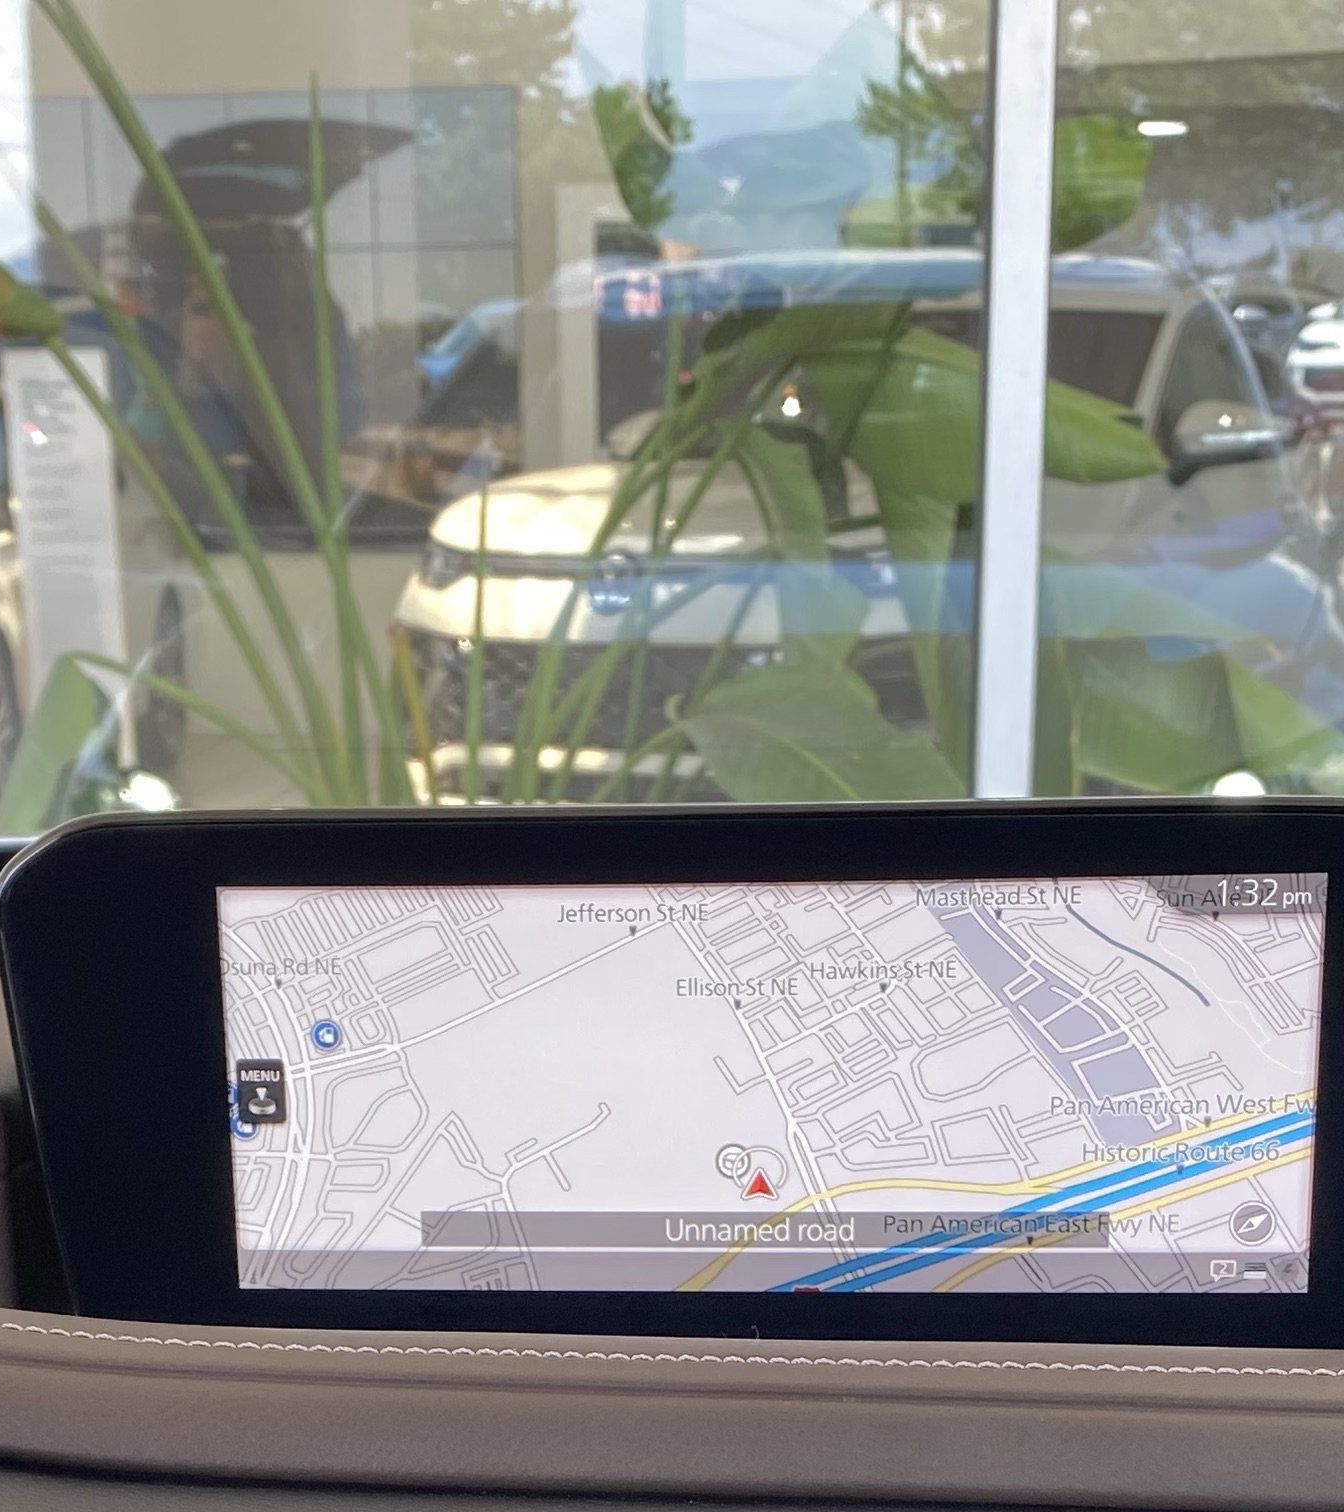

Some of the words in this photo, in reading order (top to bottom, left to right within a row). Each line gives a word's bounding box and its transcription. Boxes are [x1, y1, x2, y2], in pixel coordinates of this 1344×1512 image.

[915, 885, 1021, 907] Masthead
[1027, 885, 1047, 905] St
[1053, 885, 1082, 905] NE
[1156, 888, 1194, 908] Sun
[1217, 878, 1278, 907] 1:32
[1283, 890, 1312, 909] pm
[557, 903, 651, 923] Jefferson
[656, 903, 678, 922] St
[682, 903, 709, 922] NE
[283, 957, 309, 976] Rd
[315, 957, 342, 976] NE
[810, 961, 897, 980] Hawkins
[905, 960, 925, 980] St
[928, 960, 957, 979] NE
[676, 977, 740, 997] Ellison
[745, 977, 766, 996] St
[771, 977, 798, 996] NE
[240, 1070, 280, 1083] MENU
[1050, 1096, 1092, 1116] Pan
[1098, 1096, 1210, 1116] American
[1216, 1094, 1277, 1115] West
[1082, 1143, 1169, 1162] Historic
[1175, 1143, 1244, 1162] Route
[1251, 1141, 1280, 1161] 66
[665, 1217, 790, 1242] Unnamed
[798, 1216, 855, 1242] road
[884, 1214, 924, 1234] Pan
[931, 1214, 1038, 1234] American
[1045, 1213, 1089, 1233] East
[1098, 1213, 1143, 1239] Fwy
[1148, 1213, 1180, 1233] NE
